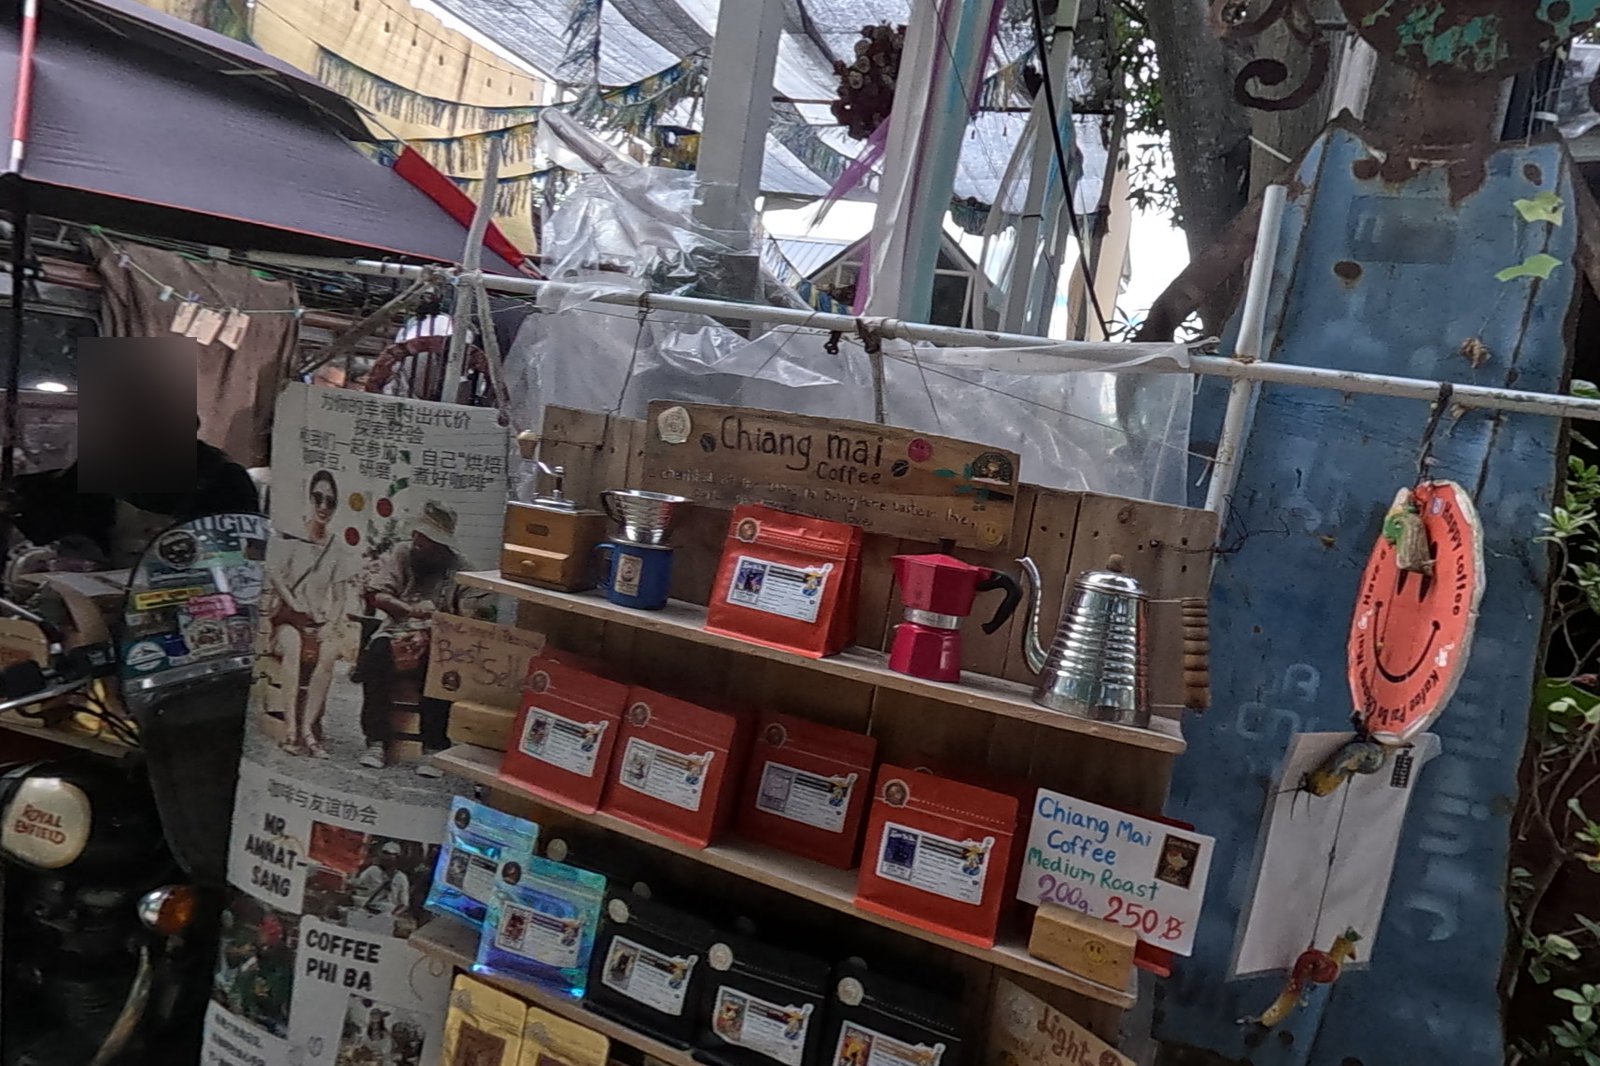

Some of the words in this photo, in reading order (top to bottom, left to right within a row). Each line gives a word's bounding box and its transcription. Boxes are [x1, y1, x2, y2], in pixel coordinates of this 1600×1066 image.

[721, 415, 812, 471] Chiang
[828, 434, 883, 467] mai
[816, 460, 882, 485] Coffee
[1442, 501, 1463, 552] Happy
[23, 803, 63, 829] ROYAL
[1038, 796, 1110, 844] Chiang
[1115, 820, 1152, 847] Mai
[1047, 830, 1117, 866] Coffee
[251, 865, 291, 898] SANG
[1027, 846, 1096, 886] Medium
[1100, 868, 1160, 901] Roast
[1103, 896, 1159, 934] 250
[306, 929, 382, 964] COFFEE
[306, 957, 338, 984] PHI
